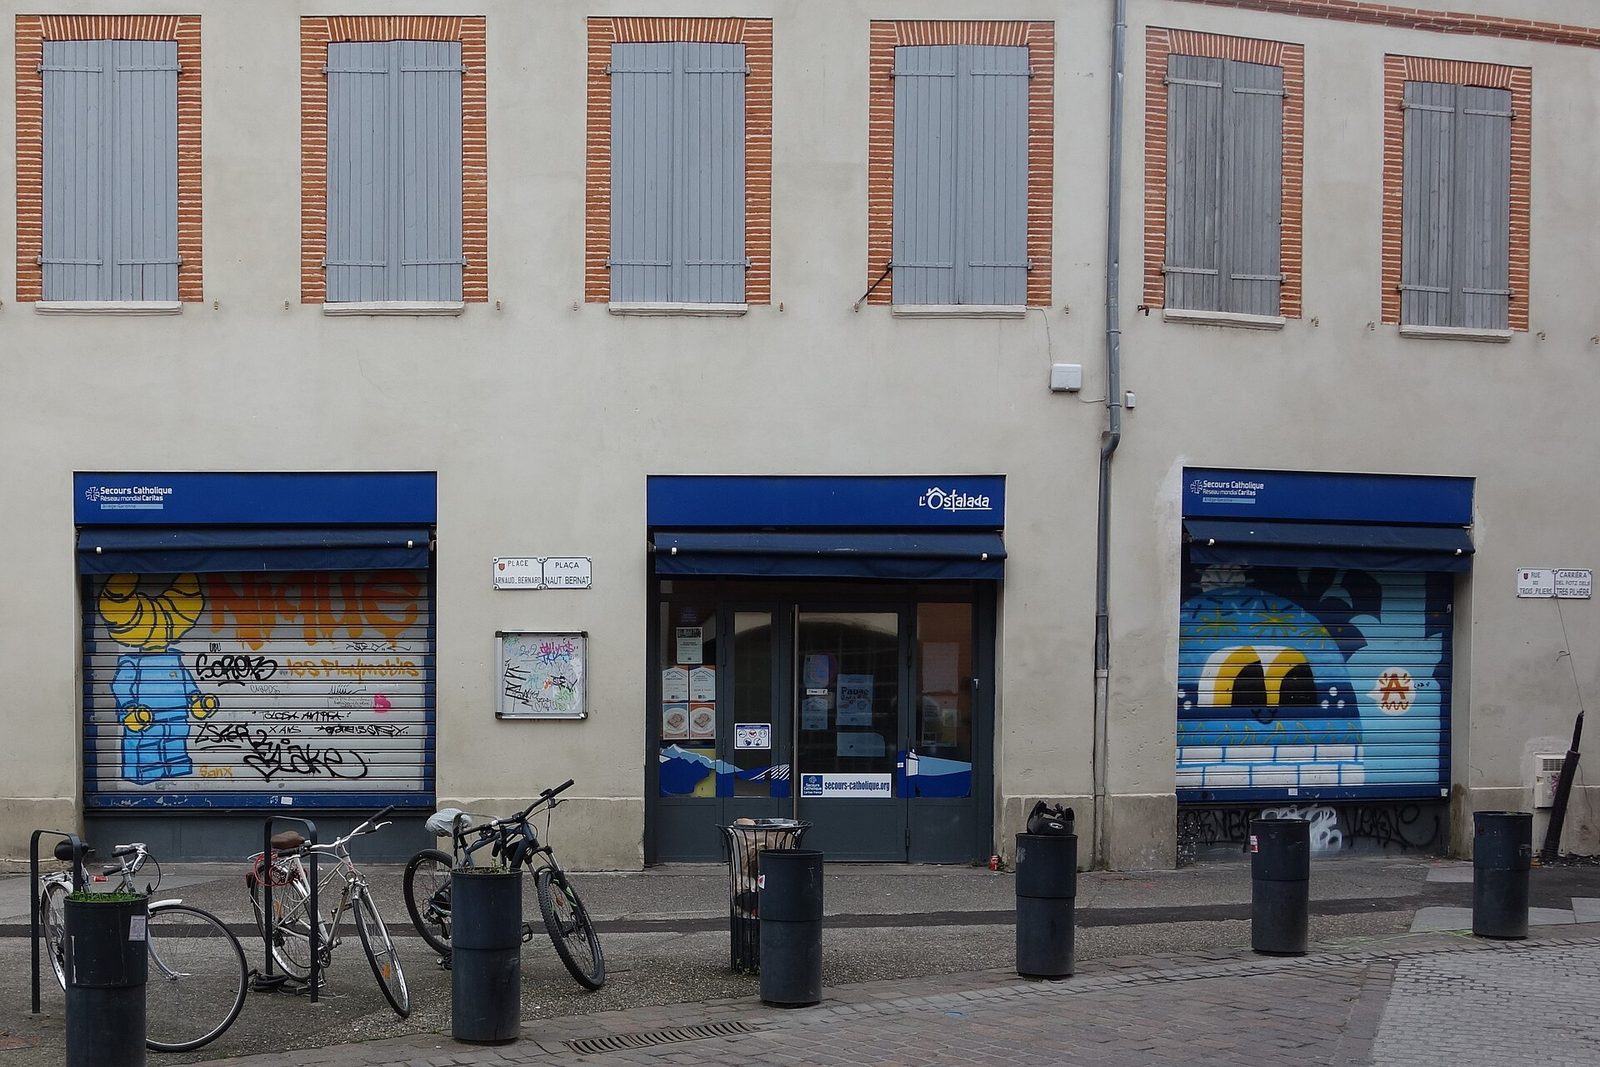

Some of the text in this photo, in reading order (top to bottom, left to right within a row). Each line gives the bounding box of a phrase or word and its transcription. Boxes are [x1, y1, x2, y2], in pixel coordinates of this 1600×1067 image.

[1203, 480, 1264, 491] Secours Catholique
[100, 486, 173, 496] Secours Catholique
[555, 561, 580, 569] PLAÇA
[545, 576, 590, 585] NAUT BERNAT
[824, 780, 890, 792] secours-catholique.org
